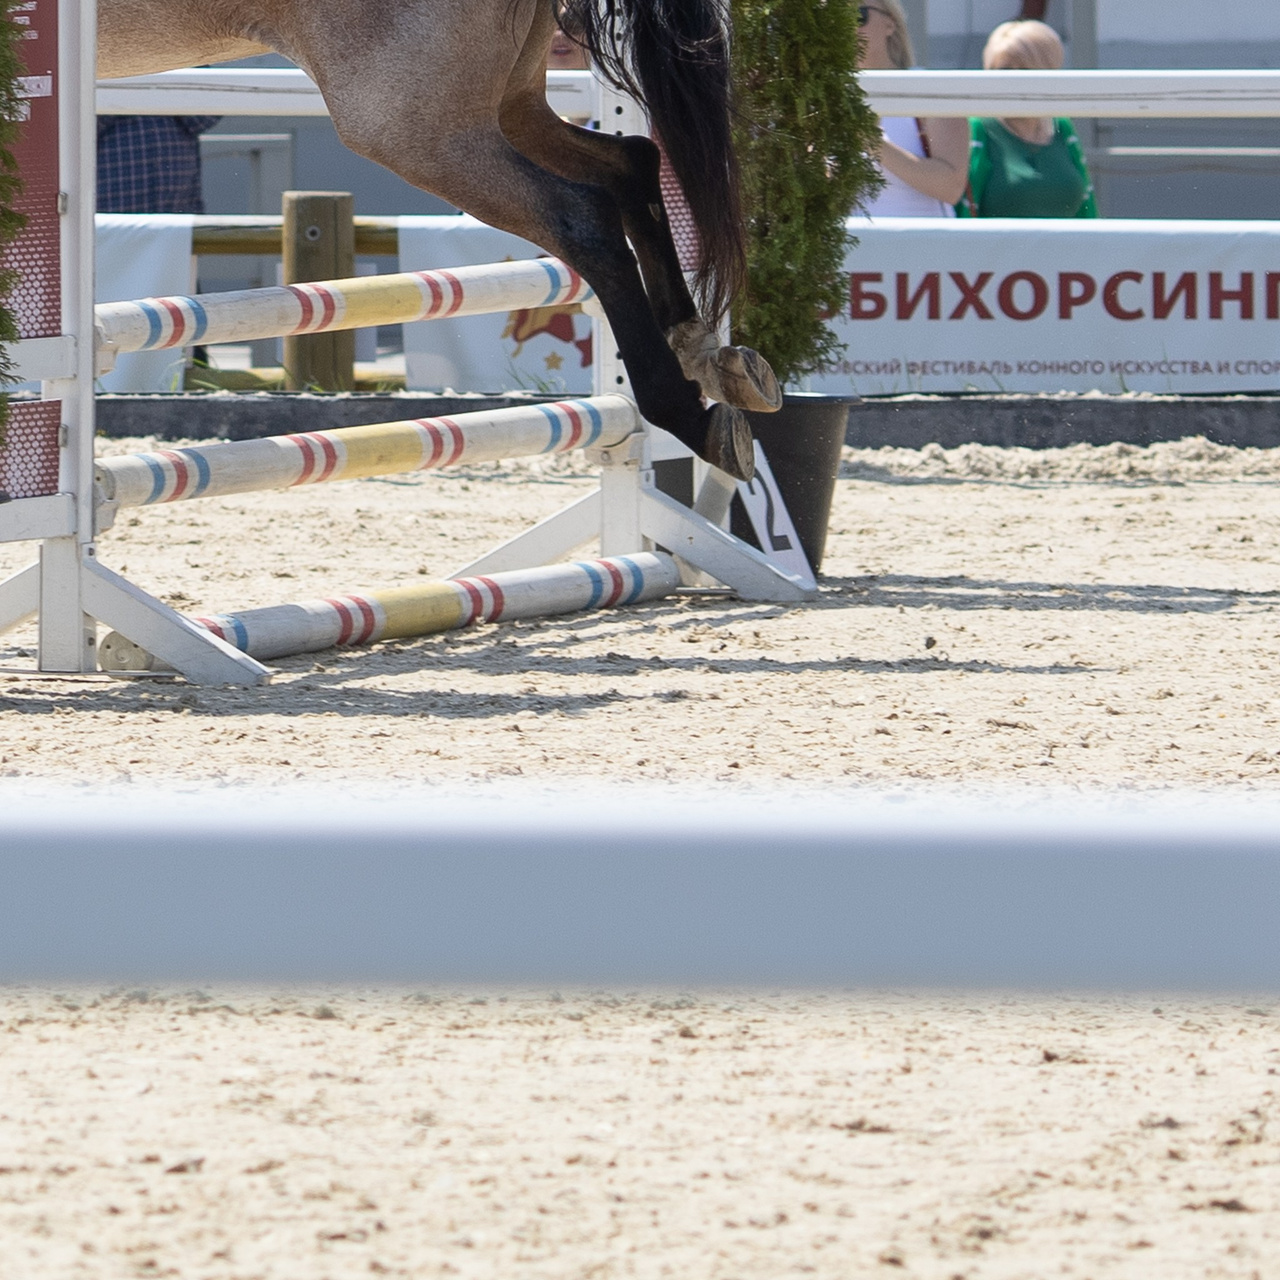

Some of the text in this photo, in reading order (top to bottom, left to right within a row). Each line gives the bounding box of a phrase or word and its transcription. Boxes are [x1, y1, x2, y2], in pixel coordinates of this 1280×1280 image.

[907, 360, 1013, 376] ФЕСТИВАЛЬ
[1017, 359, 1105, 376] КОННОГО
[1111, 359, 1214, 376] ИСКУССТВА
[1217, 360, 1231, 375] И
